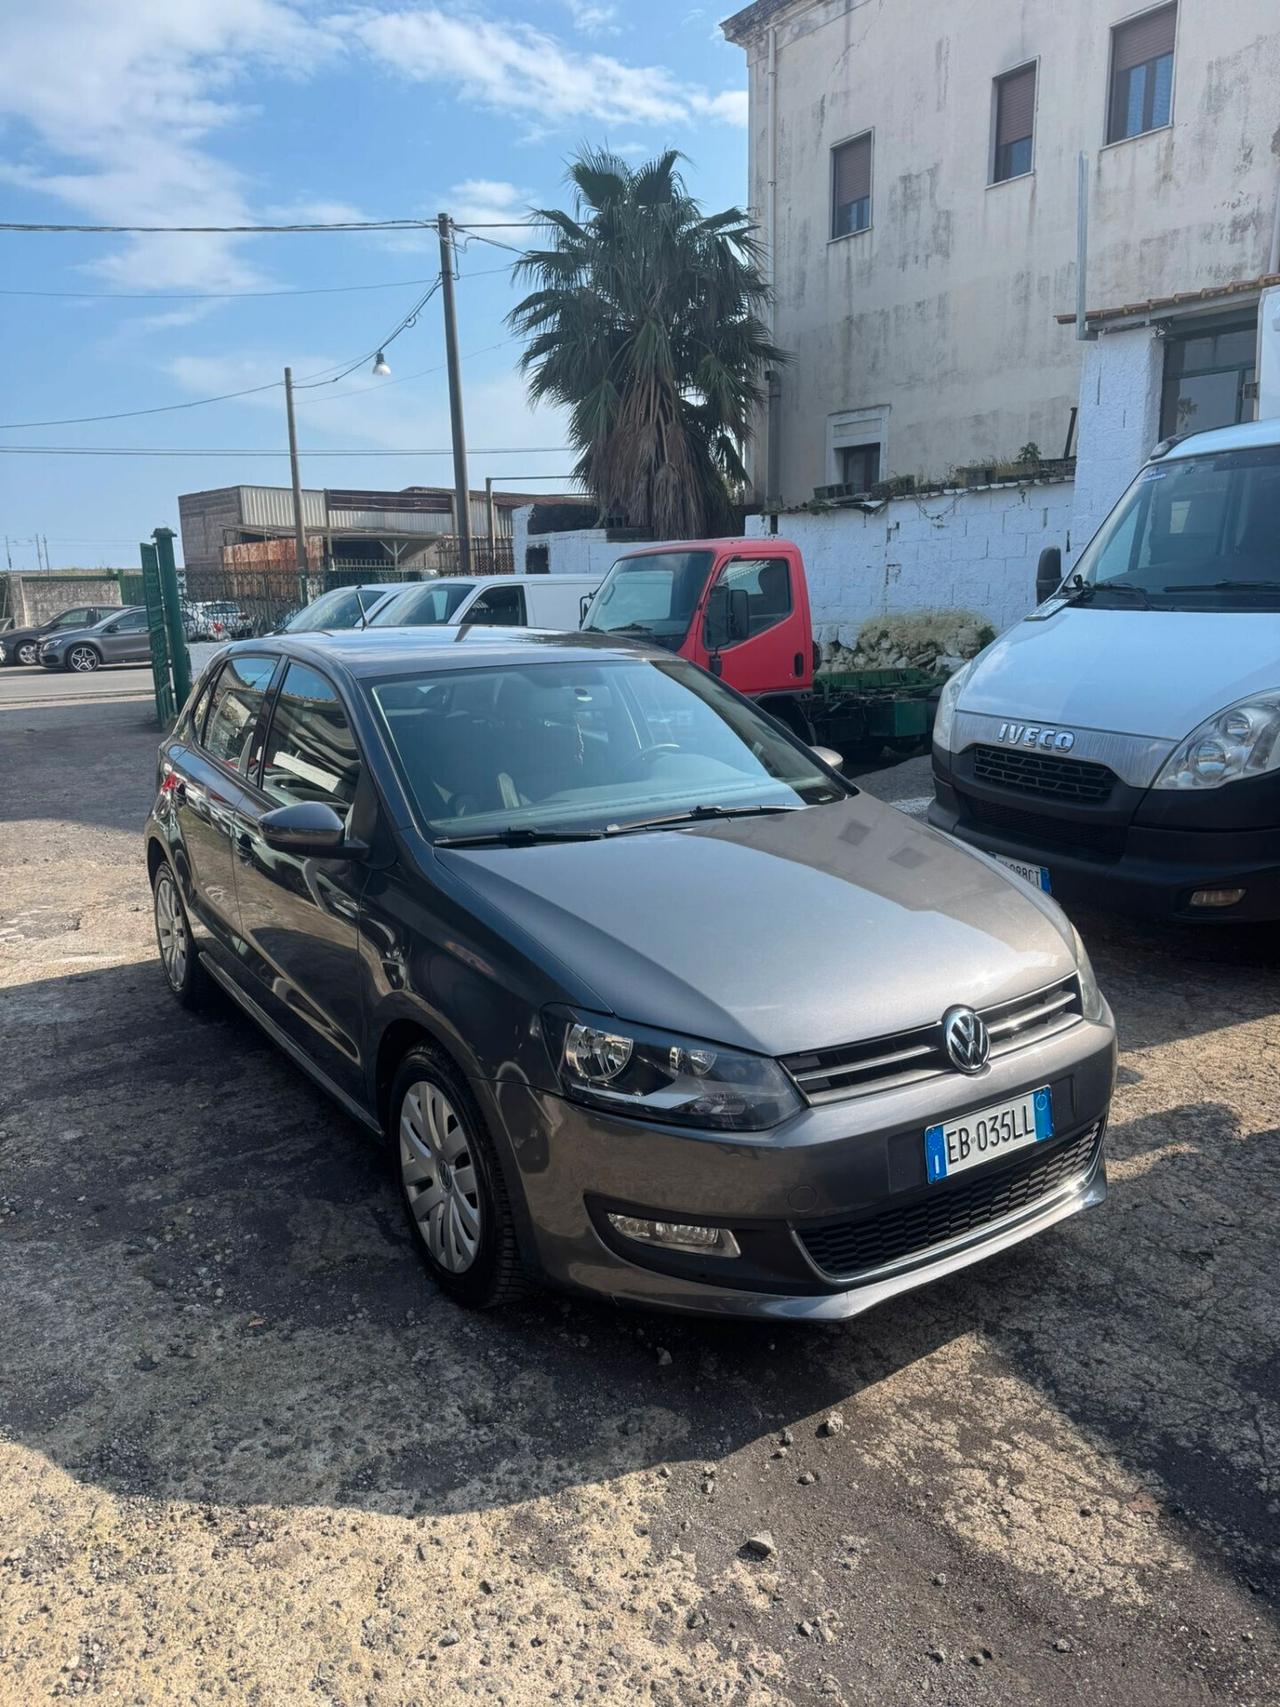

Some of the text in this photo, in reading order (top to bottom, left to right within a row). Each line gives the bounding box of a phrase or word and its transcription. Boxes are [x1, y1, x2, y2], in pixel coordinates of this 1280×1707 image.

[997, 722, 1075, 753] IVECO
[946, 1127, 970, 1164] EB
[976, 1105, 1035, 1151] 035LL
